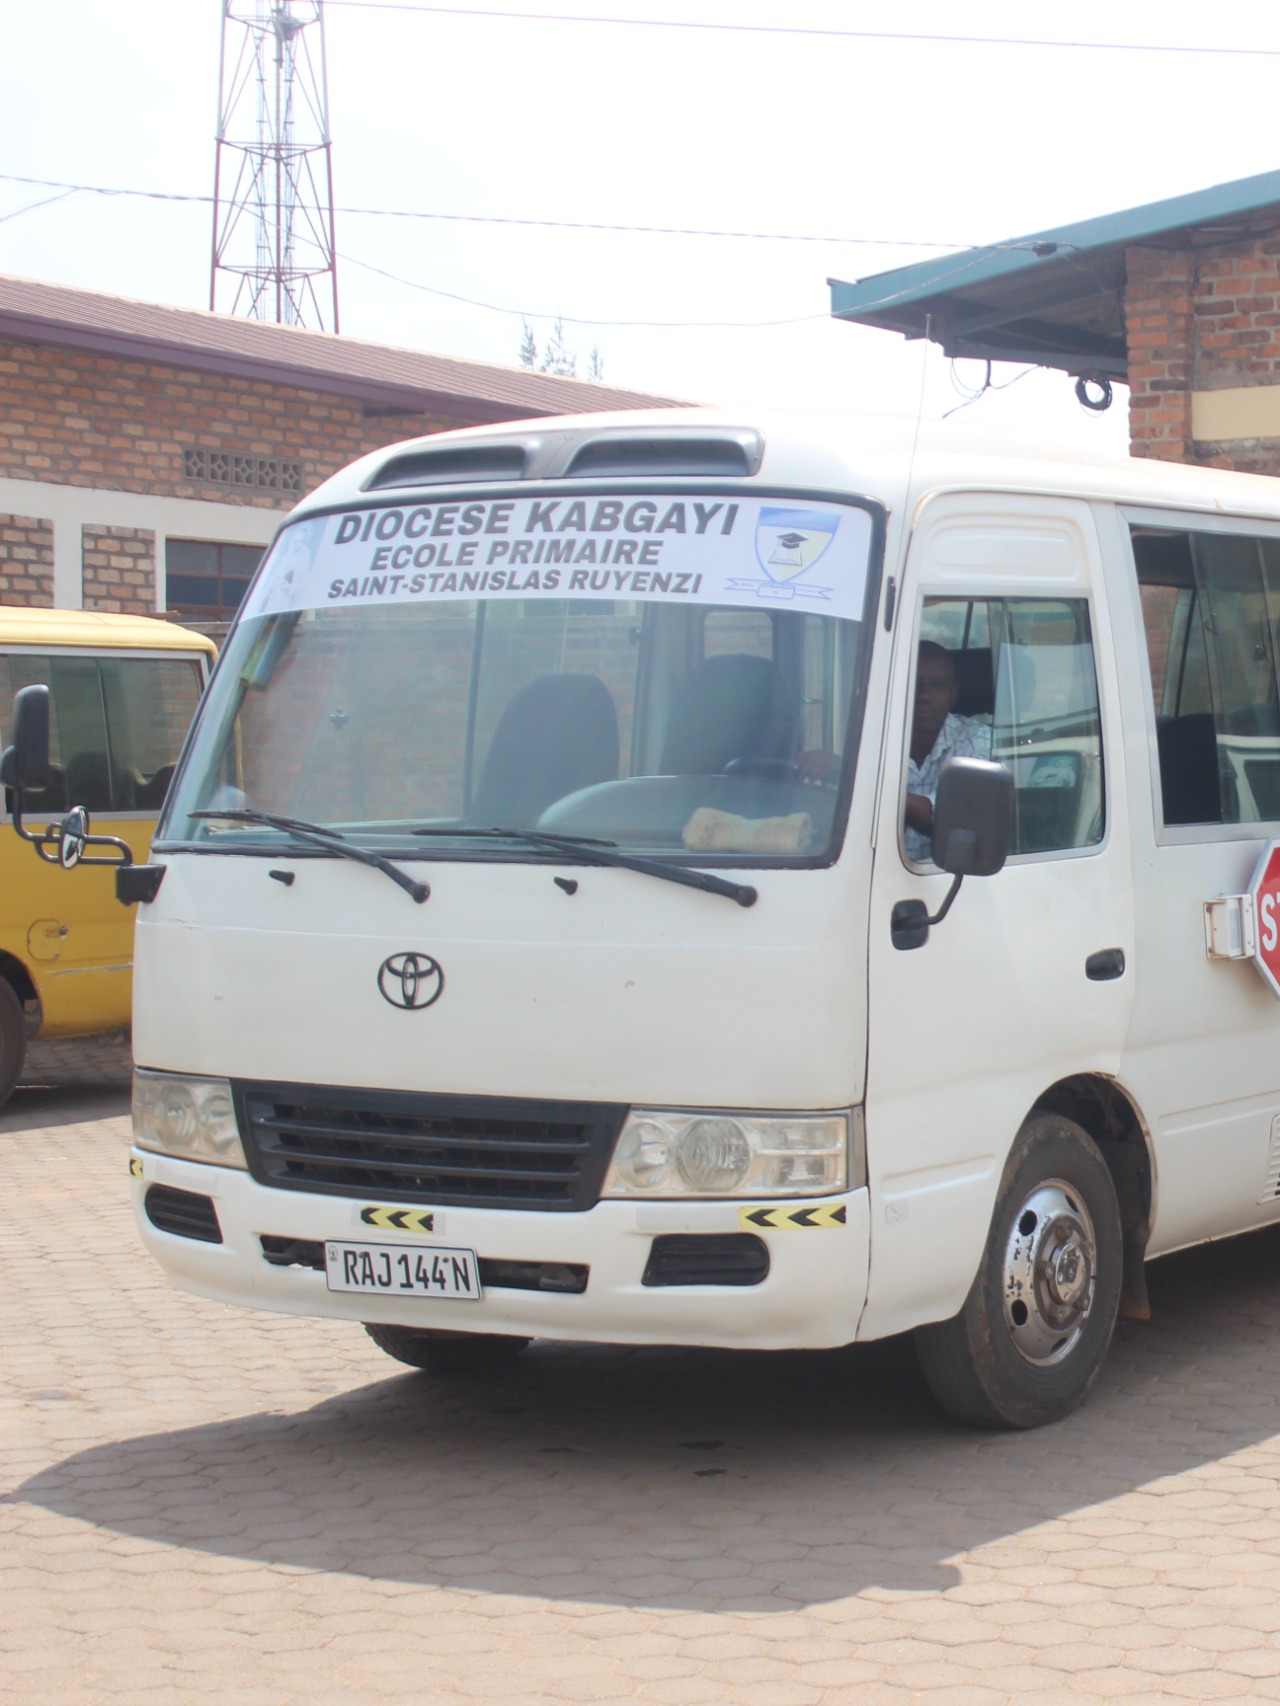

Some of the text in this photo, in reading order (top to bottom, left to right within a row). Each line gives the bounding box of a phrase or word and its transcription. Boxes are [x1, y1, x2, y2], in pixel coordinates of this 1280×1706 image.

[334, 500, 739, 544] DIOCESE KABGAYI
[370, 538, 664, 571] ECOLE PRIMAIRE
[327, 569, 703, 599] SAINT-STANISLAS RUYENZI
